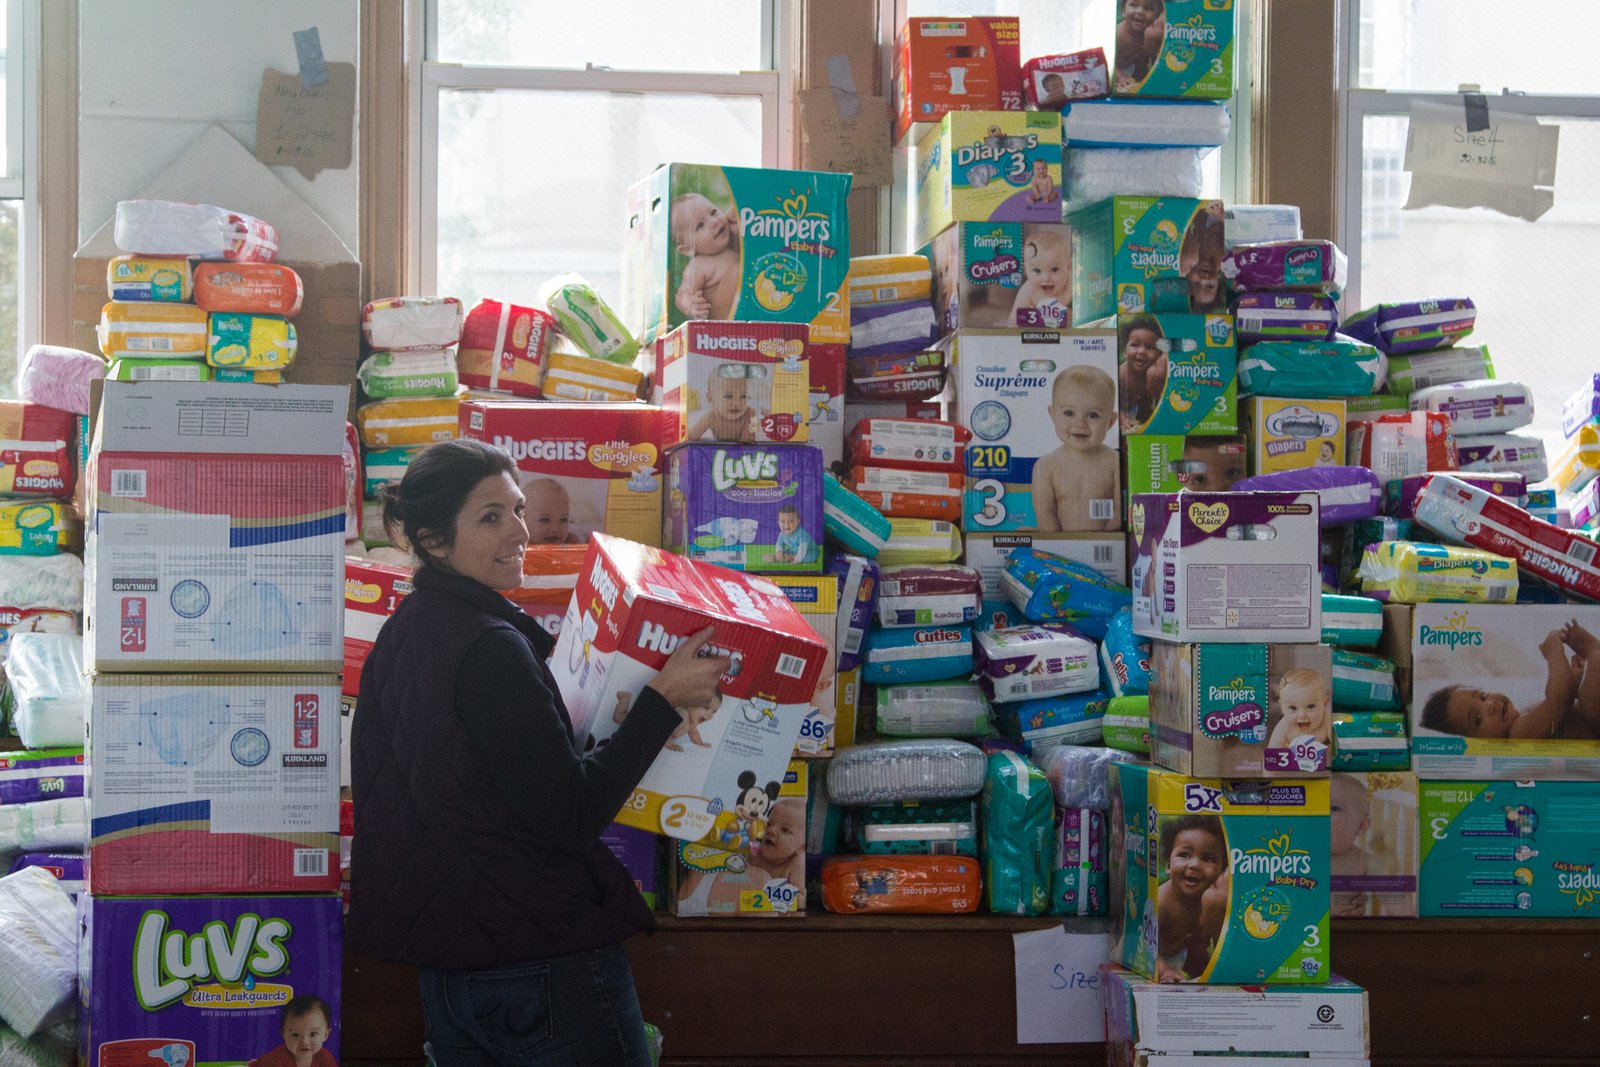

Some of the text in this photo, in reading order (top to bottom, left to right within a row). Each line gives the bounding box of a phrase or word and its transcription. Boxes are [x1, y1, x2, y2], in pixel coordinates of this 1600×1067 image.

[990, 21, 1019, 30] value
[996, 30, 1019, 39] size
[1165, 22, 1217, 46] Pampers
[1039, 55, 1079, 69] HUGGIES
[1210, 58, 1224, 75] 3
[1002, 98, 1021, 110] 72
[1453, 125, 1487, 146] Size
[1010, 151, 1027, 176] 3
[739, 207, 831, 247] Pampers
[1122, 215, 1136, 236] 3
[790, 241, 836, 259] Baby Dry
[973, 235, 1014, 252] Pampers
[1131, 249, 1181, 271] Pampers
[1250, 252, 1259, 264] 3
[971, 260, 1018, 280] Cruisers
[825, 291, 841, 313] 2
[1275, 296, 1296, 308] Luvs
[1420, 301, 1440, 314] Luvs
[1027, 311, 1038, 324] 3
[1040, 304, 1061, 319] 116
[218, 320, 244, 333] Pampers
[1210, 322, 1228, 337] 112
[526, 311, 545, 359] HUGGIES
[696, 333, 758, 350] HUGGIES
[1023, 333, 1059, 341] KIRKLAND
[761, 342, 798, 354] Snugglers
[503, 352, 514, 361] 2
[1168, 360, 1220, 379] Pampers
[404, 377, 446, 389] HUGGIES
[974, 372, 1048, 392] Suprême
[1213, 395, 1228, 413] 3
[1449, 399, 1495, 410] Premium Diapers
[764, 419, 774, 433] 2
[493, 435, 587, 461] HUGGIES
[605, 440, 630, 450] Little
[1267, 440, 1305, 456] diapers
[14, 452, 20, 463] 1
[592, 446, 651, 466] Snugglers
[972, 446, 1008, 468] 210
[712, 449, 779, 492] Luvs
[15, 477, 65, 489] HUGGIES
[753, 488, 783, 498] babies
[972, 478, 1008, 527] 3
[1267, 504, 1286, 514] 100%
[1192, 506, 1226, 518] Parent's
[1195, 516, 1222, 526] Choice
[995, 536, 1032, 545] KIRKLAND
[1433, 558, 1473, 570] Diapers
[1476, 561, 1484, 571] 3
[1521, 549, 1582, 586] HUGGIES
[114, 582, 156, 591] KIRKLAND
[589, 552, 620, 613] HUGGIES
[904, 584, 915, 593] 36
[387, 596, 396, 611] 1
[934, 611, 963, 621] diapers
[121, 627, 145, 646] 1-2
[914, 629, 962, 643] Cuties
[1420, 625, 1483, 651] Pampers
[1112, 652, 1130, 687] Cuties
[1209, 686, 1256, 704] Pampers
[294, 700, 318, 719] 1-2
[1053, 705, 1072, 715] baby
[1060, 710, 1085, 720] diapers
[1207, 708, 1261, 732] Cruisers
[800, 720, 825, 739] 86
[284, 754, 326, 763] KIRKLAND
[1278, 751, 1289, 767] 3
[1296, 744, 1317, 761] 96
[41, 777, 65, 793] Luvs
[1457, 790, 1474, 803] 112
[665, 802, 687, 828] 2
[1430, 817, 1449, 840] 3
[1230, 848, 1311, 882] Pampers
[1275, 875, 1316, 890] Baby Dry
[1558, 867, 1600, 890] mpers
[766, 886, 792, 902] 140
[902, 885, 923, 895] scoot
[924, 884, 940, 893] and
[941, 884, 961, 893] crawl
[753, 894, 763, 908] 2
[1269, 903, 1281, 915] 12
[1303, 925, 1320, 947] 3
[134, 910, 290, 1009] Luvs
[1301, 961, 1319, 971] 204
[1051, 963, 1101, 990] Size
[191, 989, 287, 1004] Ultra Leakguards
